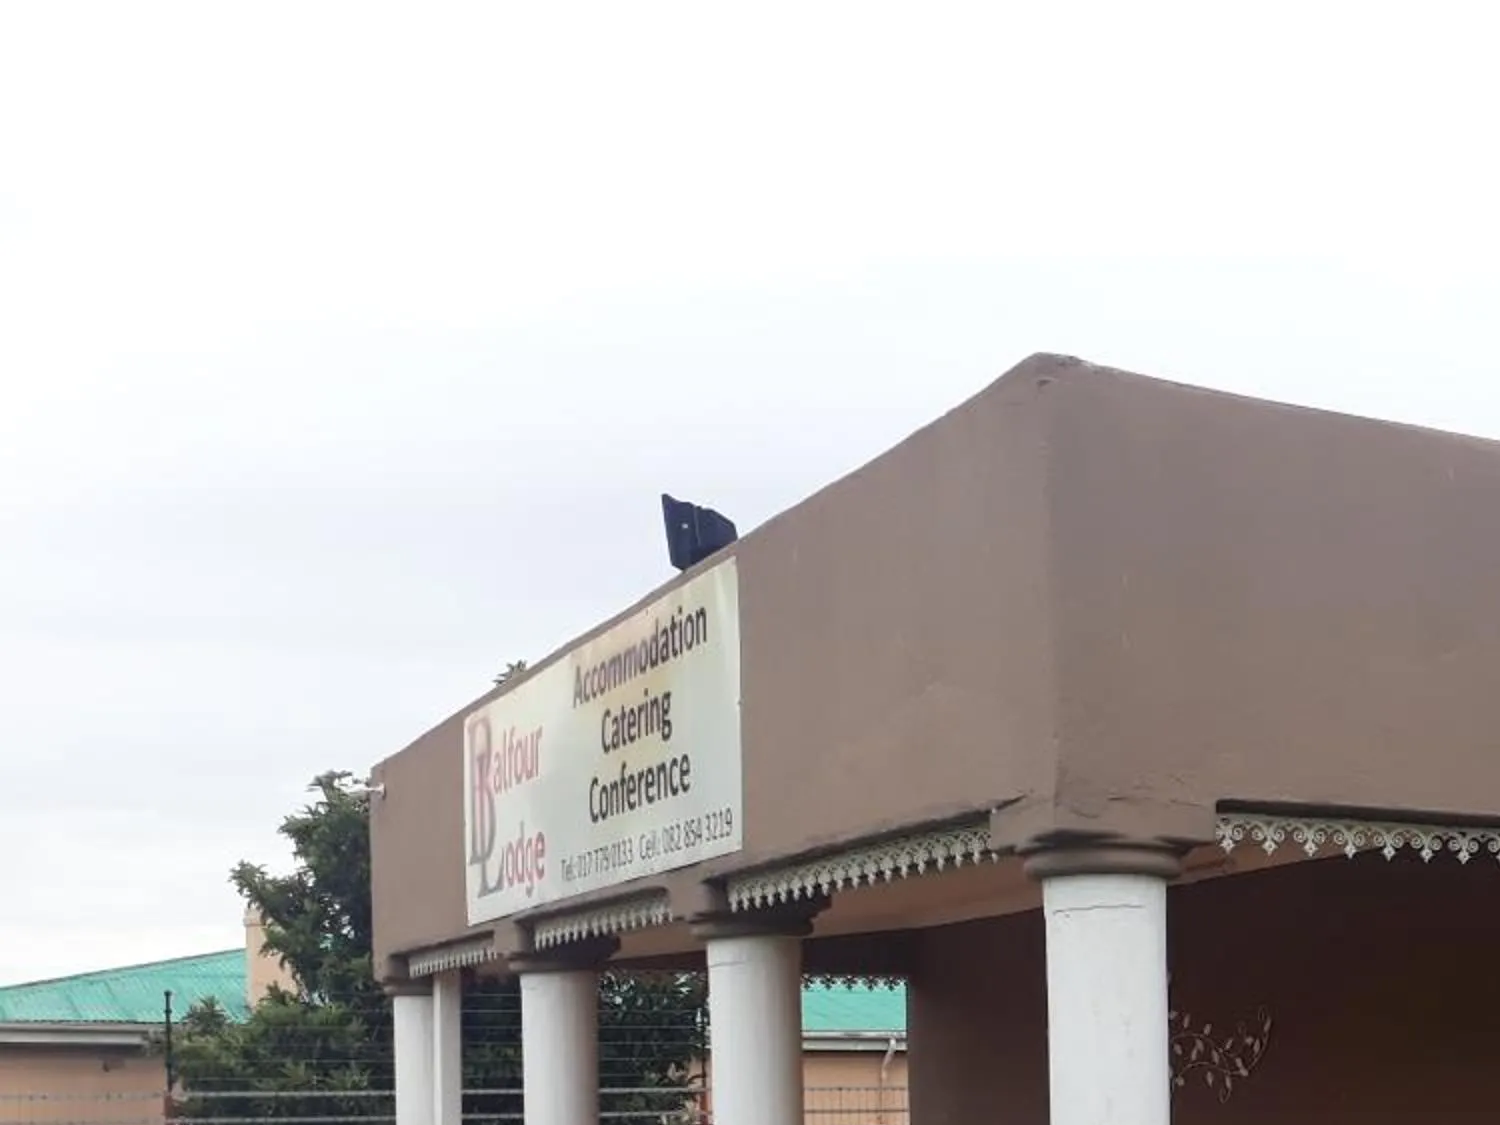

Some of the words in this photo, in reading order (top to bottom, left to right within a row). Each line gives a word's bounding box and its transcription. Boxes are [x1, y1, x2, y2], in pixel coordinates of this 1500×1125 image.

[573, 605, 708, 709] Accommodation
[601, 687, 673, 754] Catering
[468, 713, 544, 866] Balfour
[589, 753, 691, 824] Conference
[684, 816, 702, 848] 854
